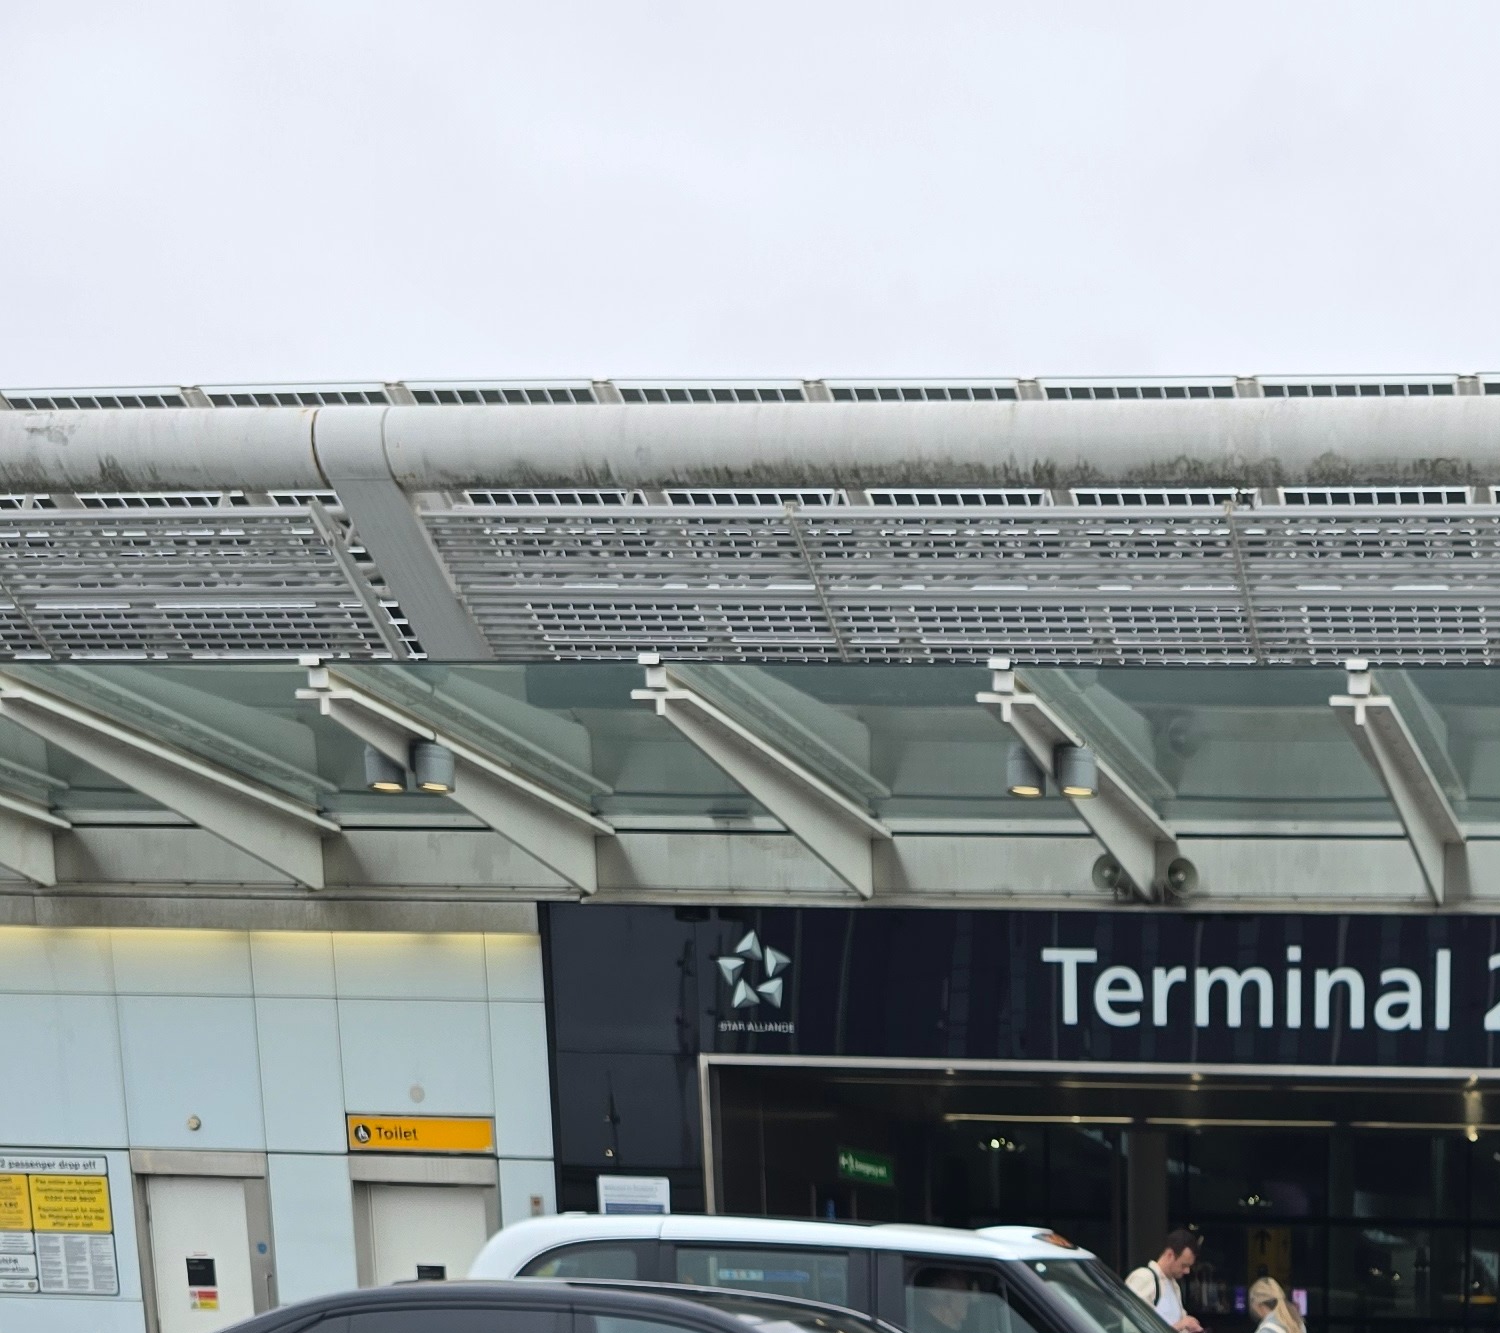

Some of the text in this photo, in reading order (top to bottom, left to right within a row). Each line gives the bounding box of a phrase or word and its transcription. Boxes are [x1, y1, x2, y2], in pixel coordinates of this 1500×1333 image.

[1041, 945, 1451, 1031] Terminal
[718, 1021, 795, 1034] STAR ALLIANCE
[376, 1125, 418, 1141] Toilet
[8, 1160, 56, 1171] passenger
[59, 1160, 81, 1171] drop
[82, 1160, 97, 1170] off
